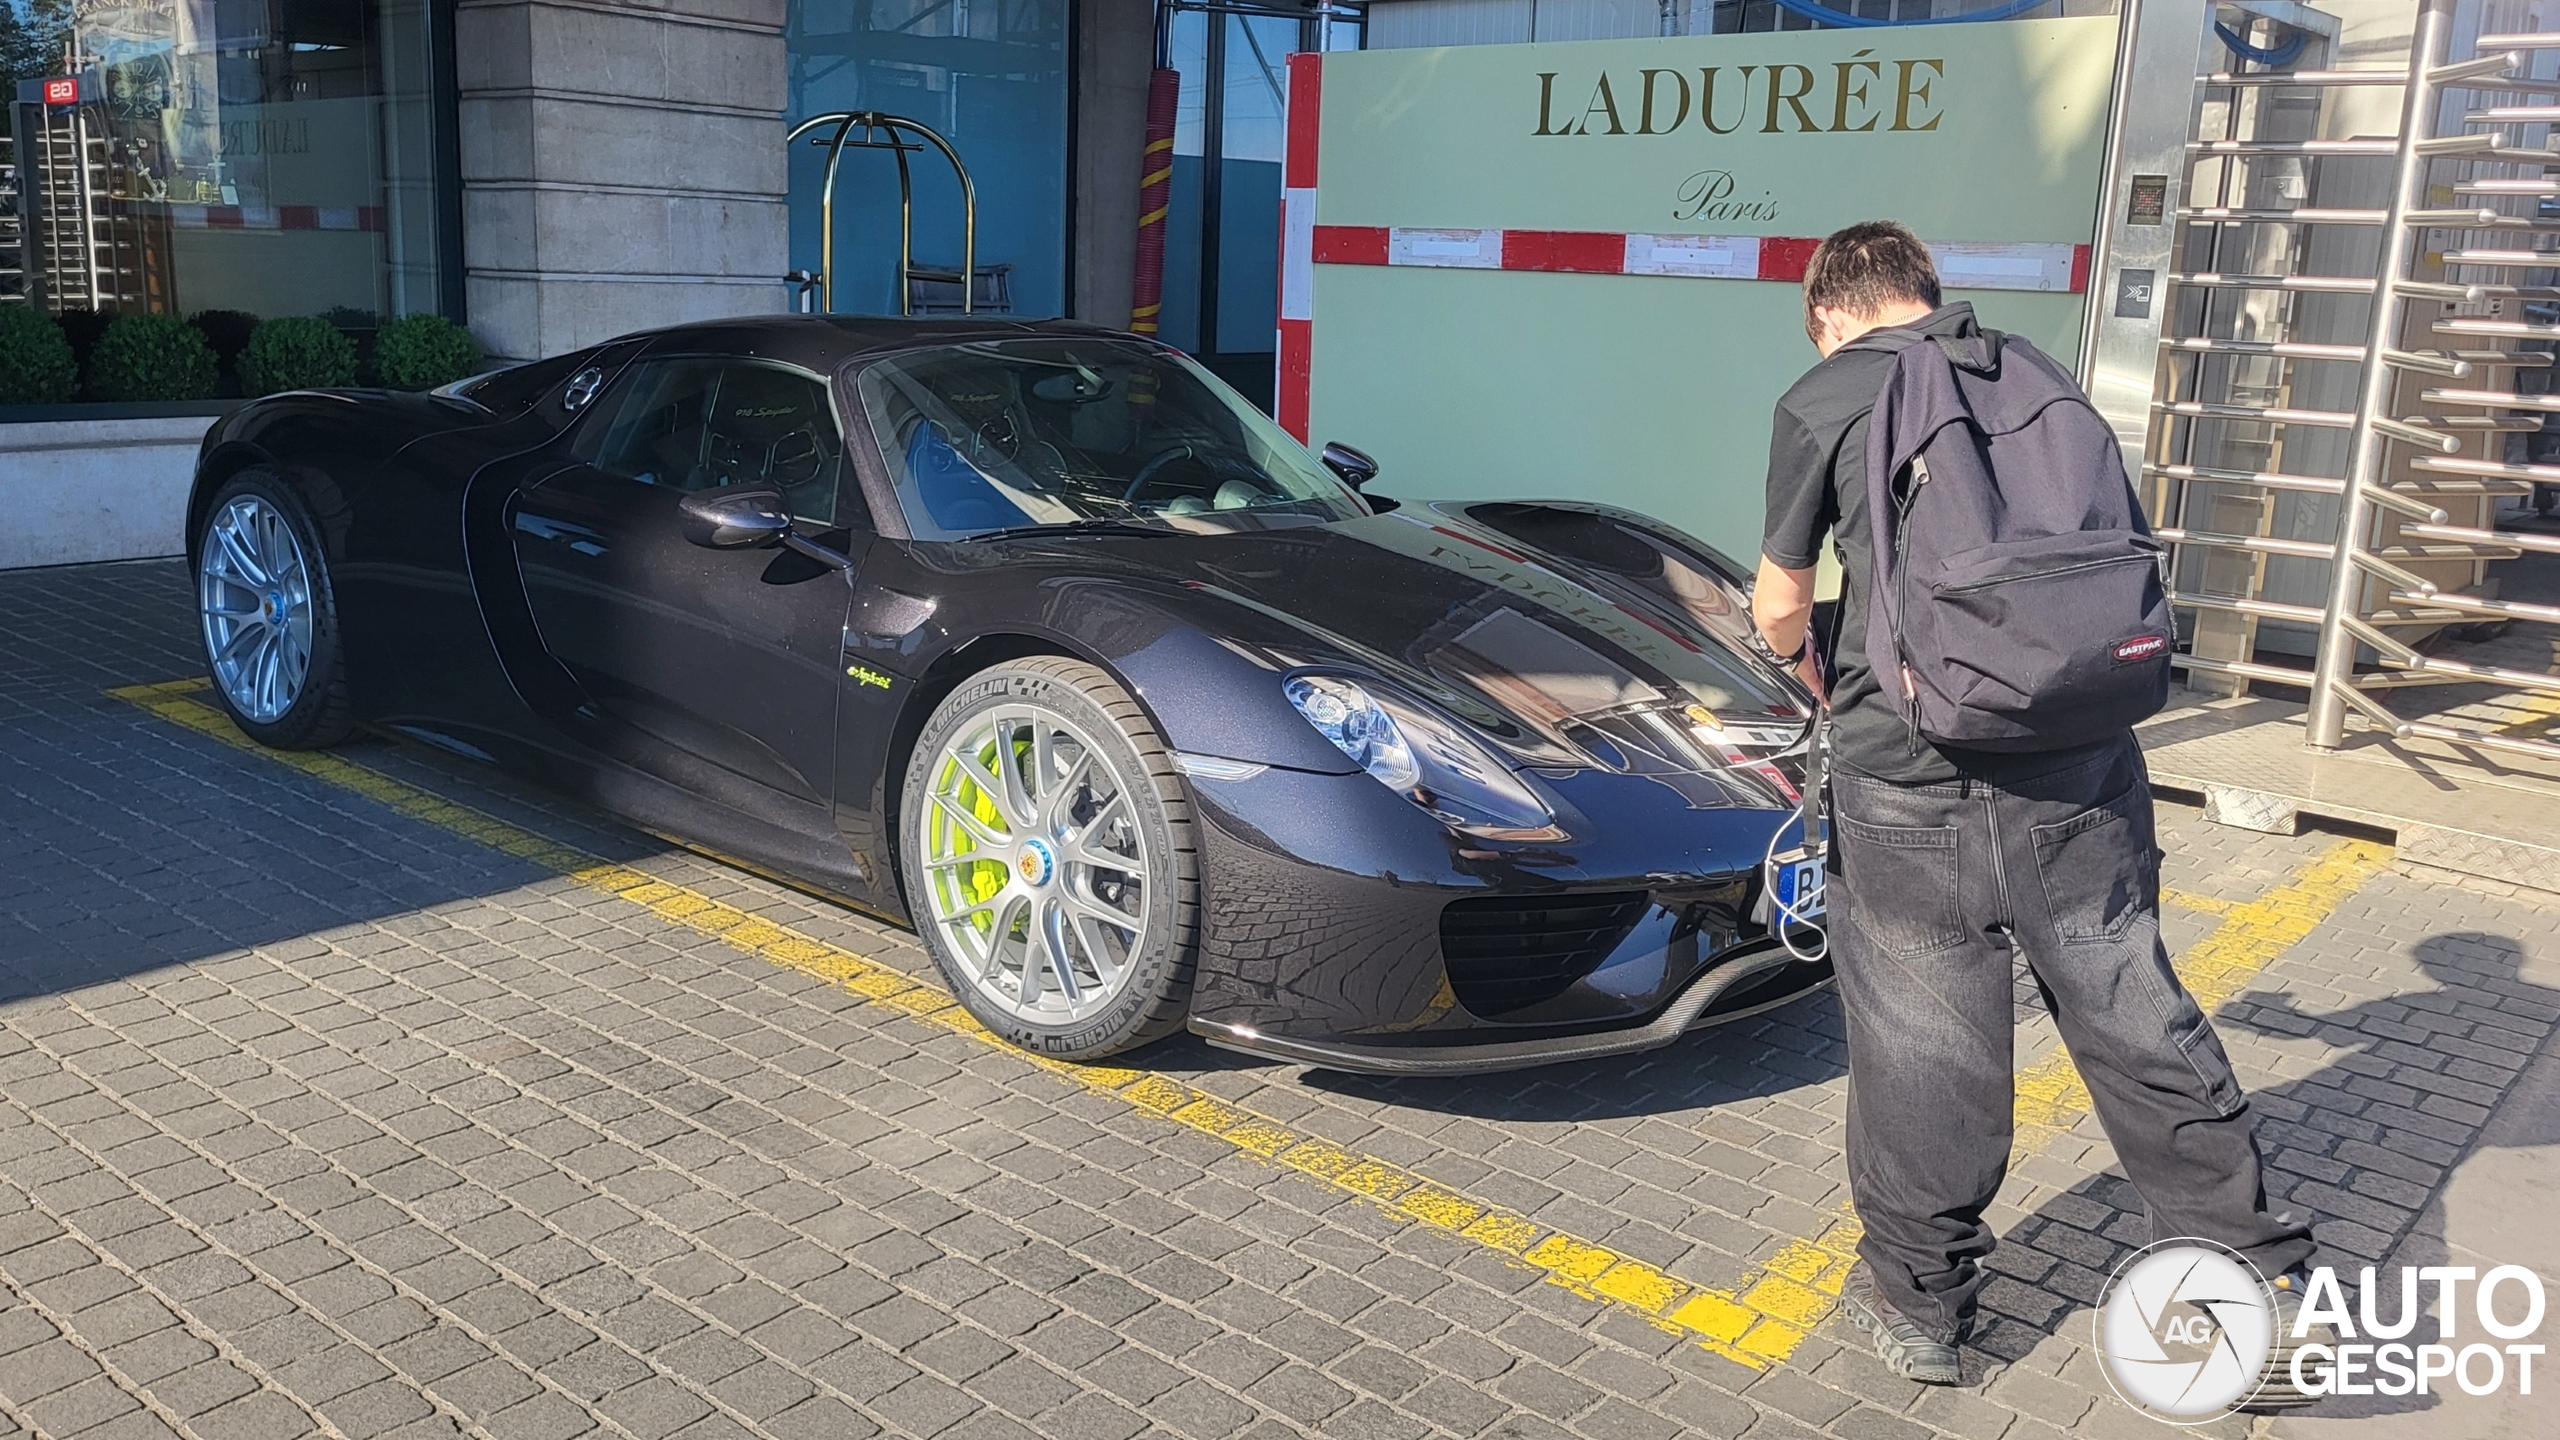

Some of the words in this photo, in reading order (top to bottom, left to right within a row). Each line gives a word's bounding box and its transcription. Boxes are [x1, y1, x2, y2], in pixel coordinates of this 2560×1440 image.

[1530, 48, 1945, 136] LADURÉE
[1673, 169, 1780, 222] Paris
[754, 406, 798, 419] Spyder
[2118, 640, 2162, 657] EASTPAK
[937, 678, 1008, 732] MICHELIN
[1048, 1011, 1127, 1052] MICHELIN
